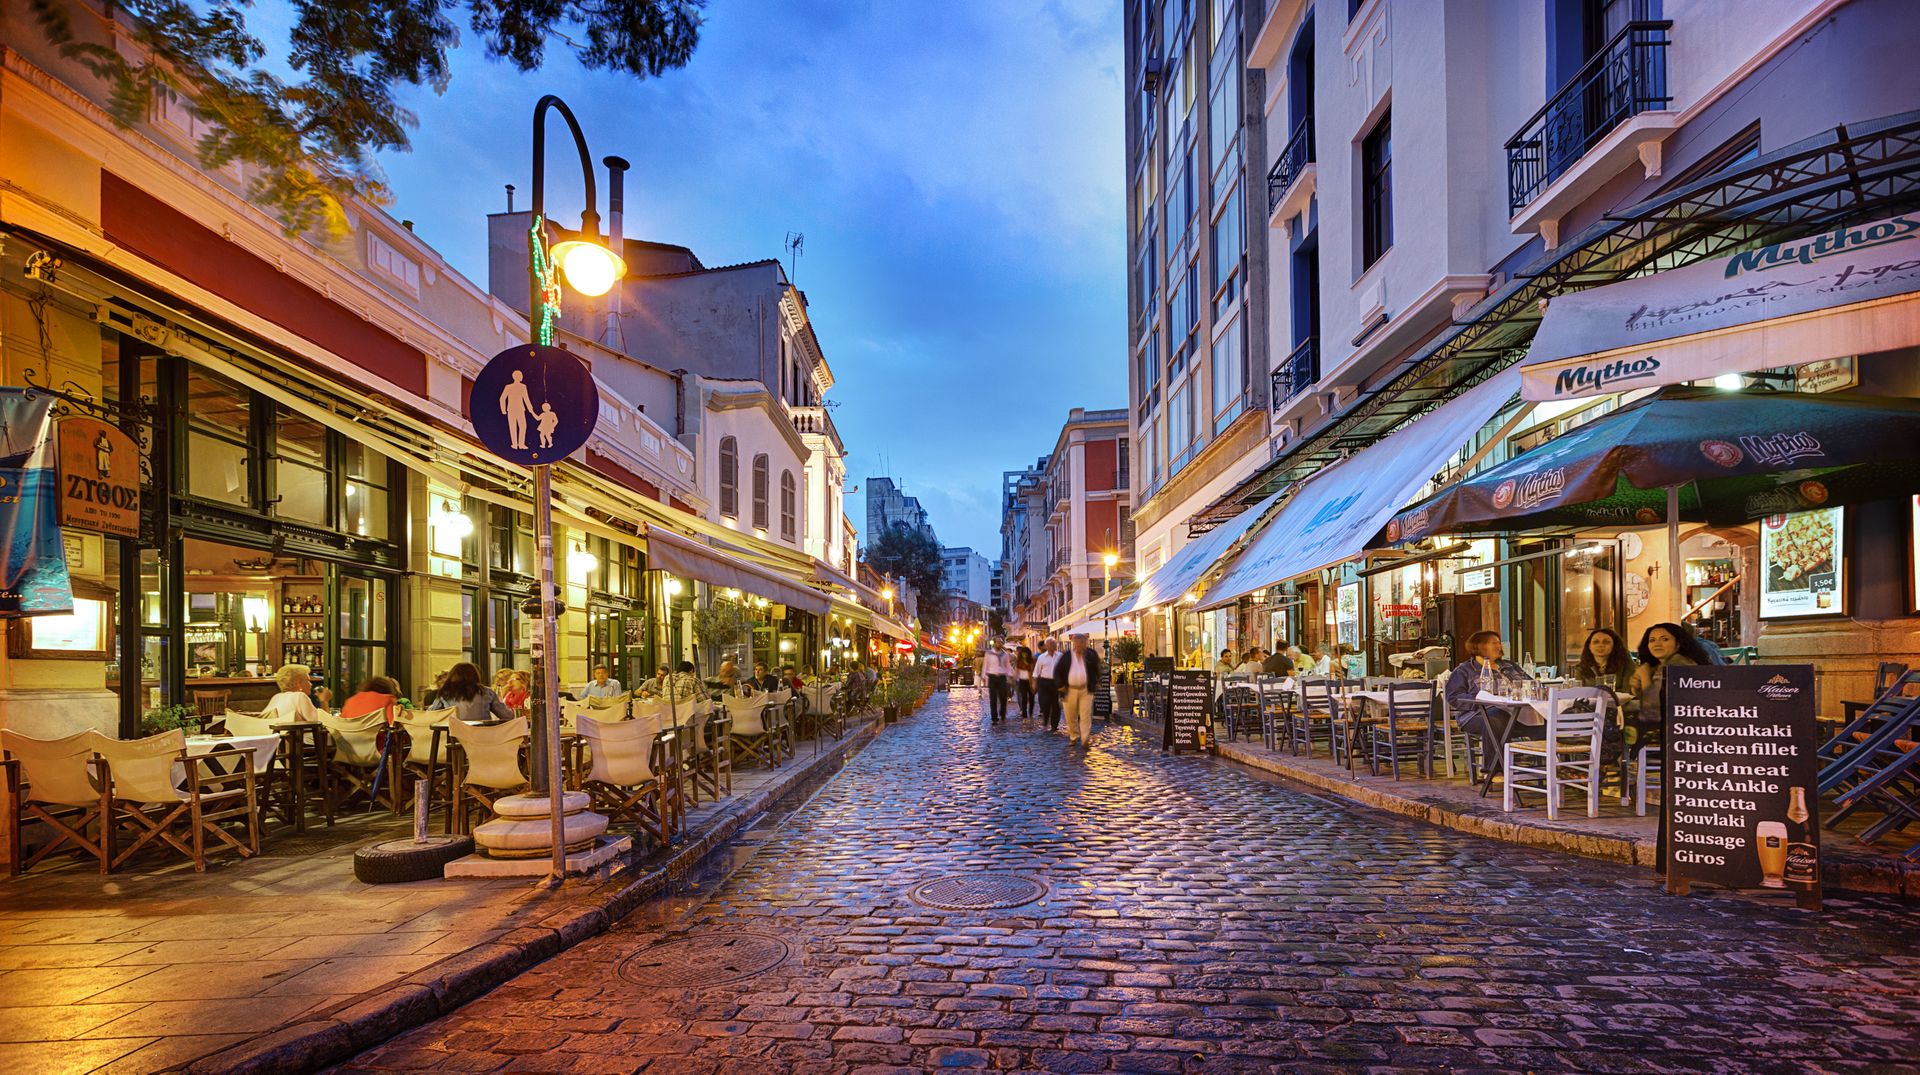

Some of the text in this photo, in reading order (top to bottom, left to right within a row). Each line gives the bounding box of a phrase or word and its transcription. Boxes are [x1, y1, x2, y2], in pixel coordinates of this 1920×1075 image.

[1554, 355, 1661, 394] Mythos
[1740, 432, 1825, 465] Mythos
[1513, 467, 1566, 509] Mythos
[1680, 677, 1721, 689] Menu
[1673, 705, 1759, 718] Biftekaki
[1673, 723, 1792, 737] Soutzoukaki
[1673, 740, 1799, 756] Chicken fillet
[1674, 760, 1790, 776] Fried meat
[1674, 777, 1779, 793] Pork Ankle
[1674, 794, 1757, 811] Pancetta
[1674, 811, 1746, 828] Souvlaki
[1674, 830, 1746, 850] Sausage
[1675, 850, 1726, 866] Giros
